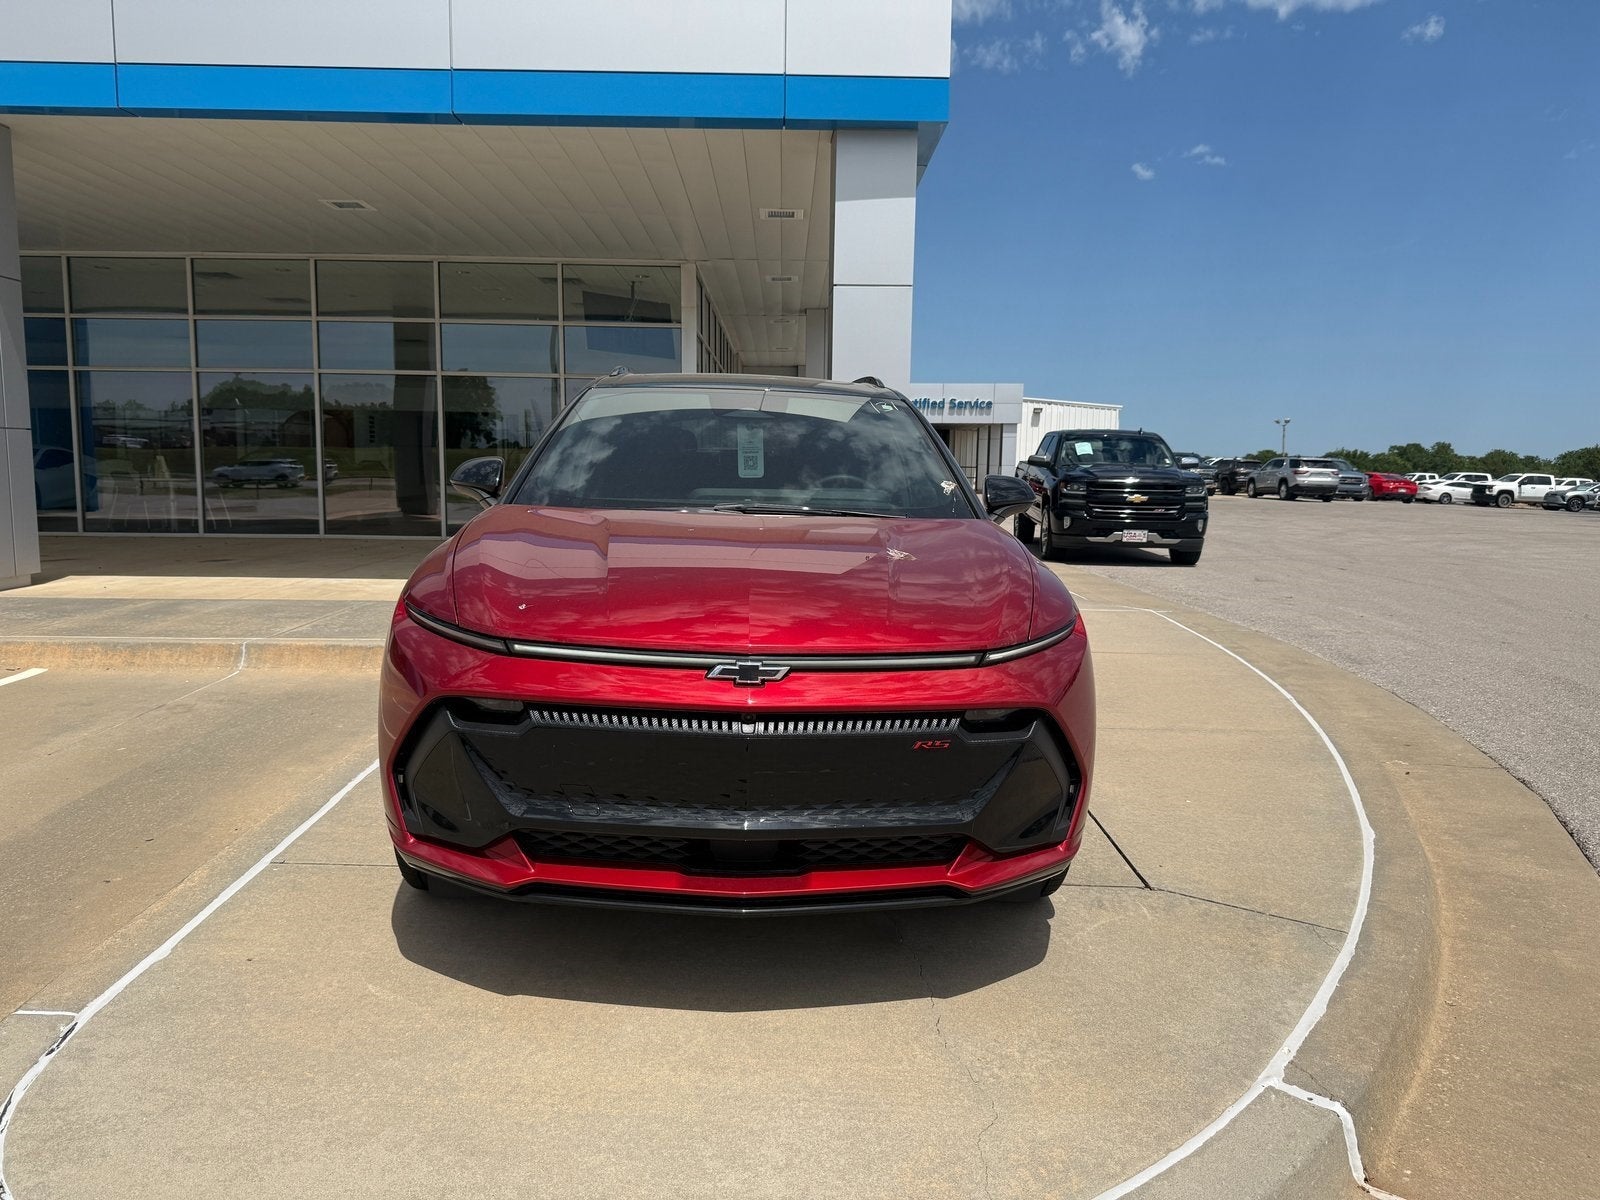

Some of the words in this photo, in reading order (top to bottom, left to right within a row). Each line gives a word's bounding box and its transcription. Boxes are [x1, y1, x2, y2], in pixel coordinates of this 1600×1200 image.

[911, 397, 945, 409] tified
[949, 398, 993, 409] Service
[912, 740, 951, 750] RS
